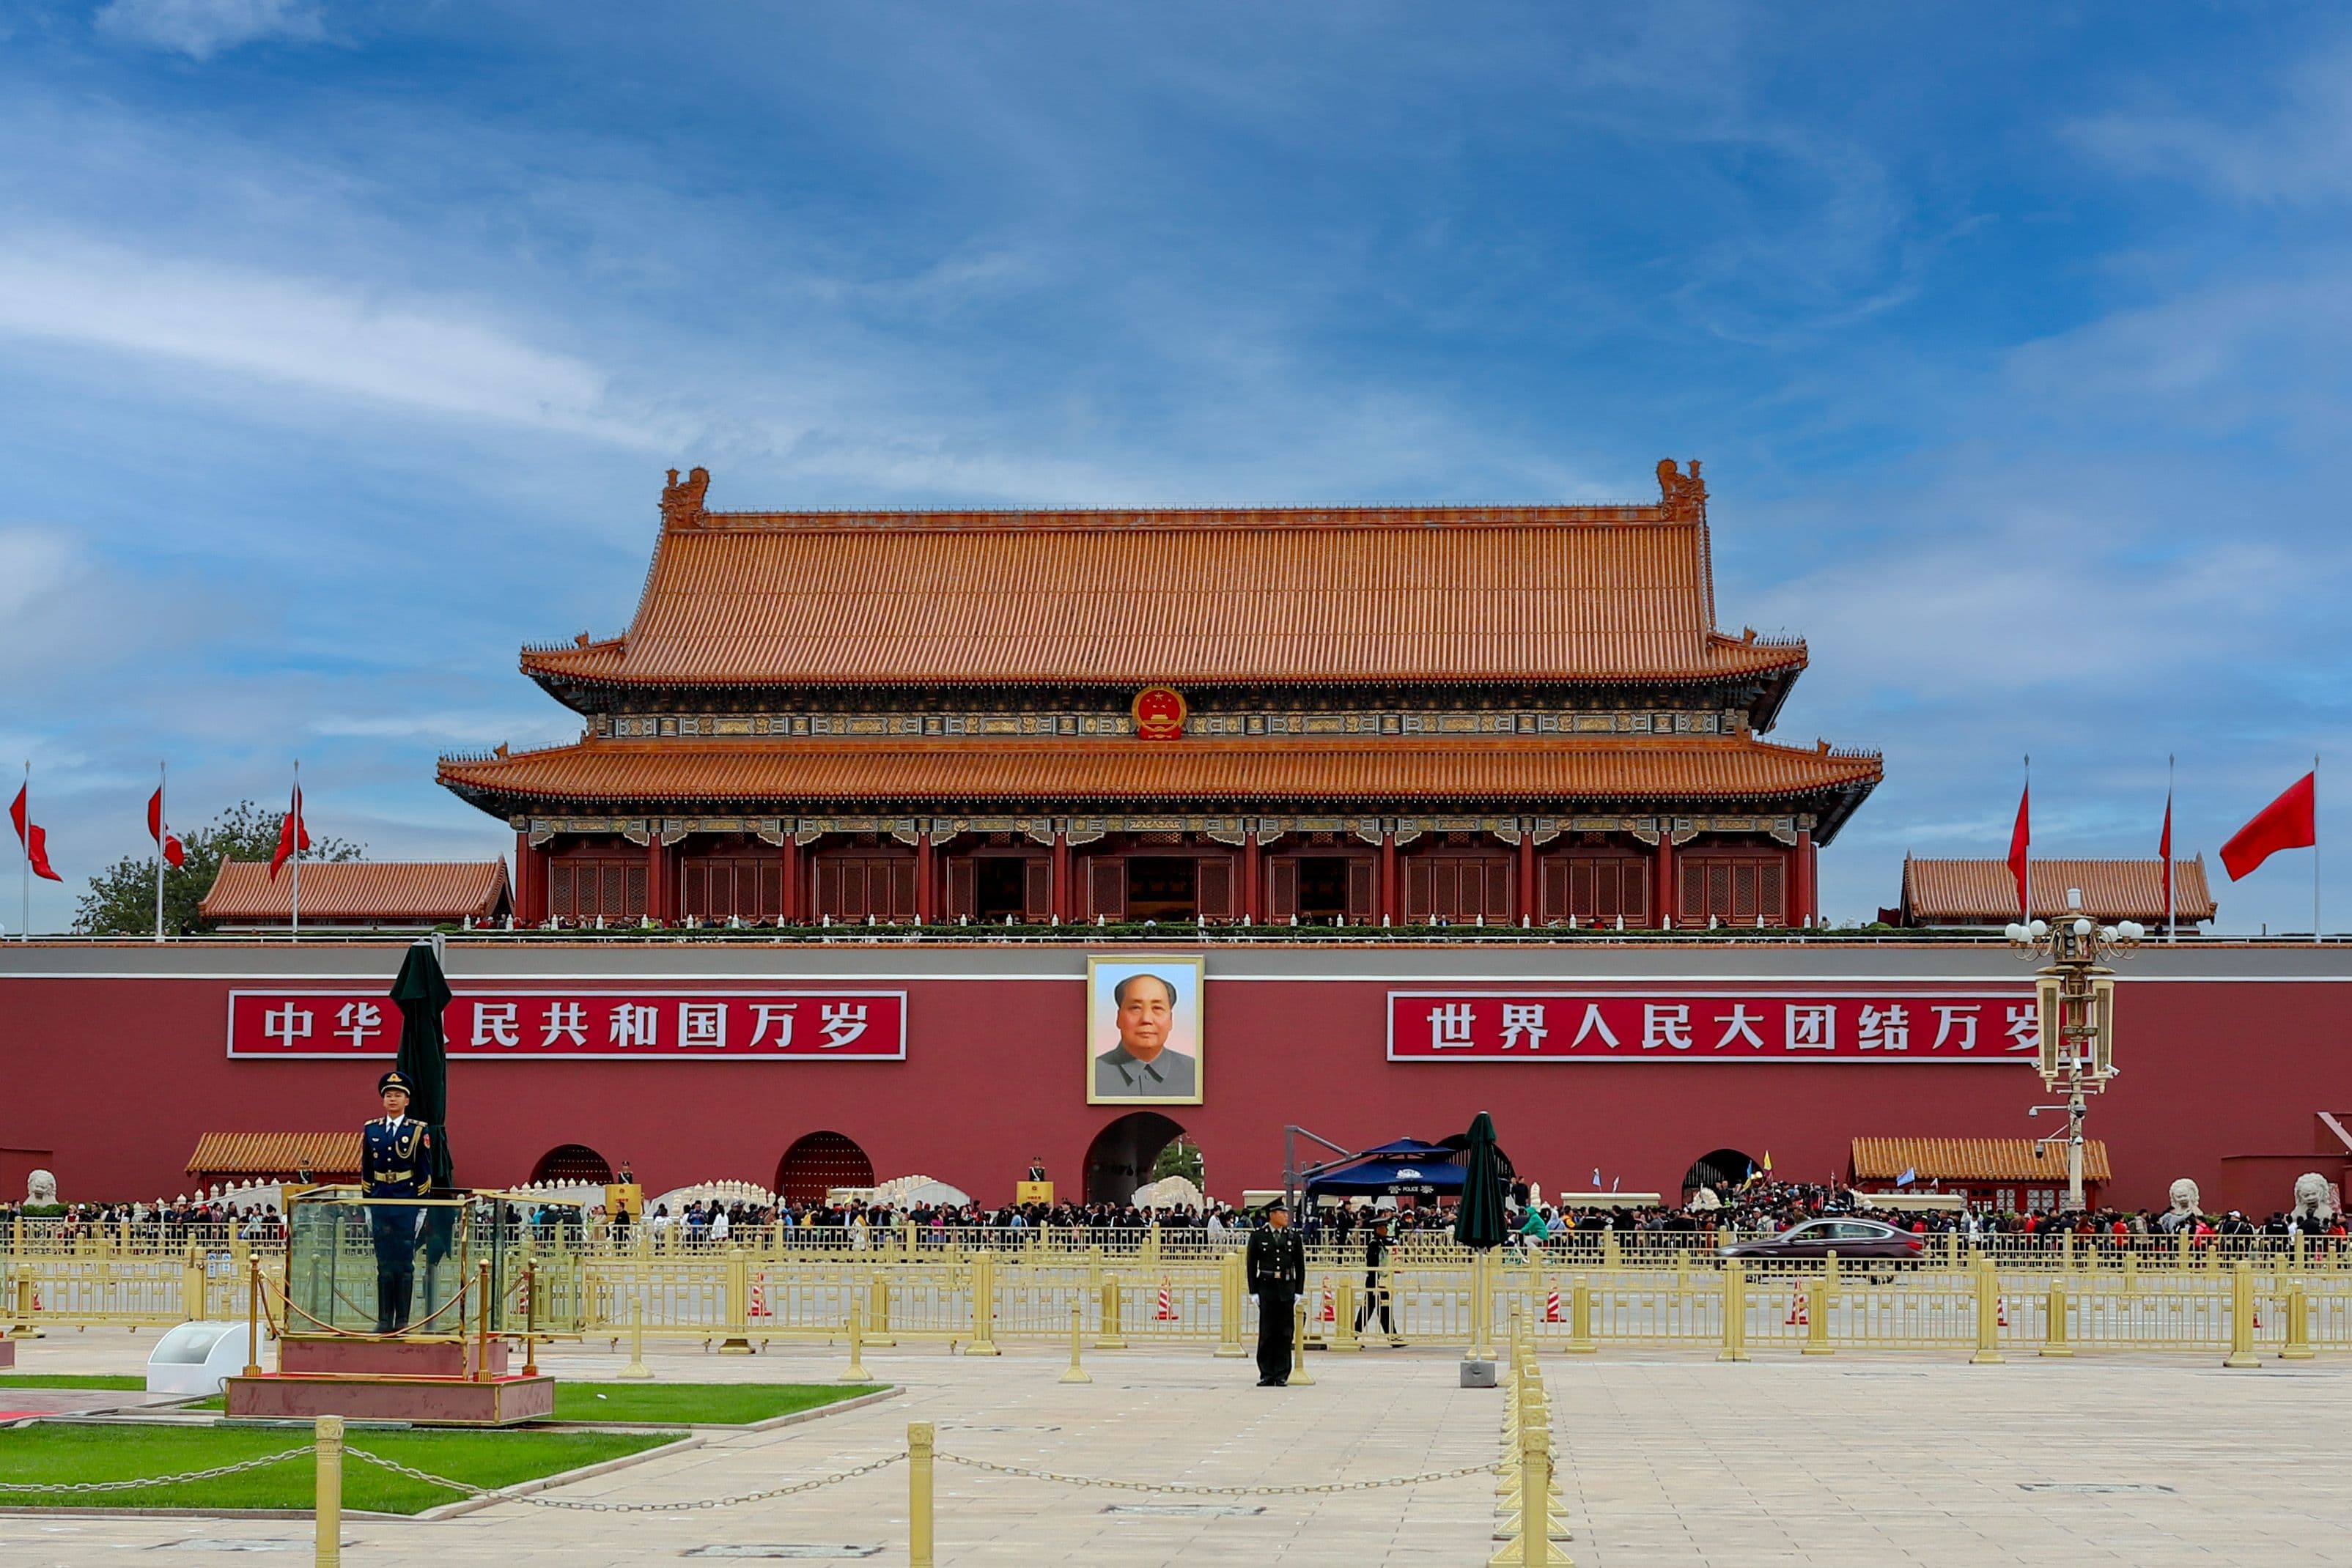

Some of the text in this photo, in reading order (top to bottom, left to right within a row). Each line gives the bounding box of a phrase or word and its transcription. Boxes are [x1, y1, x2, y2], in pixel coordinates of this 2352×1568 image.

[264, 1002, 869, 1048] 中华民共和国万岁
[1426, 1003, 2040, 1051] 世界人民大团结万岁
